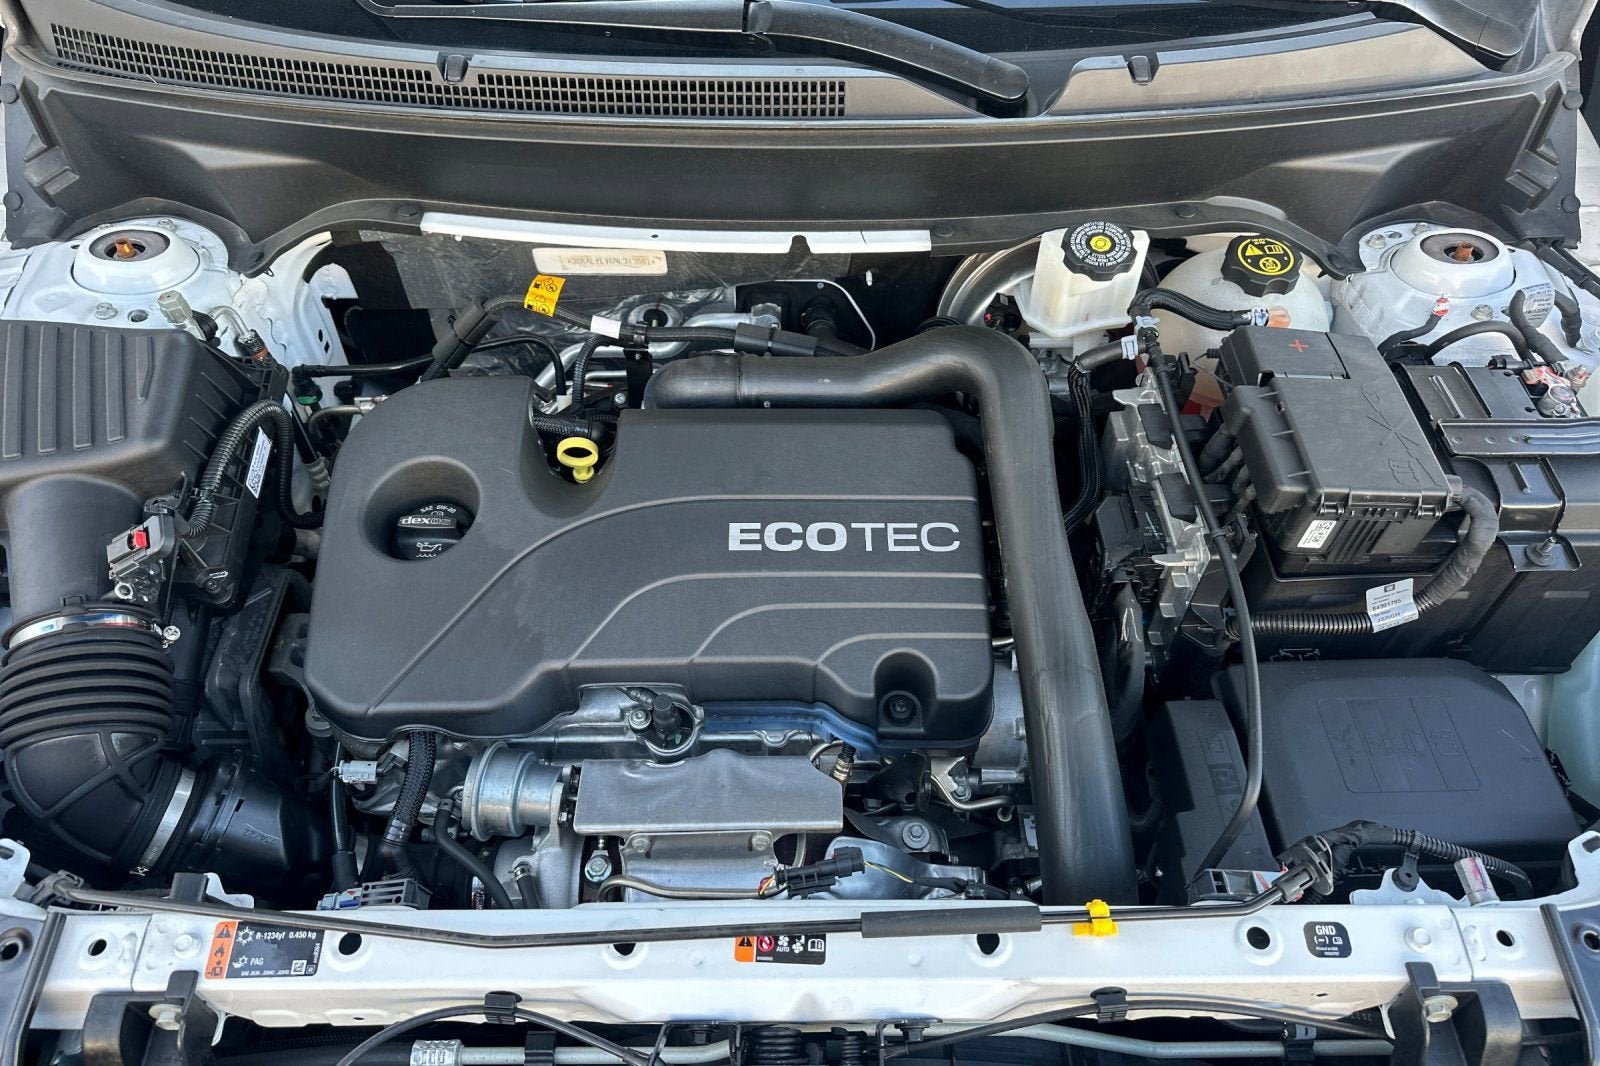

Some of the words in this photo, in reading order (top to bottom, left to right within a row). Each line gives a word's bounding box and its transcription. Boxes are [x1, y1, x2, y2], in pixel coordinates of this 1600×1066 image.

[420, 505, 434, 513] SAE
[728, 521, 961, 552] ECOTEC
[256, 931, 286, 940] R-1234yf
[288, 930, 307, 939] 0.450
[307, 931, 317, 940] kg
[1315, 925, 1336, 935] GND
[250, 957, 264, 966] PAG
